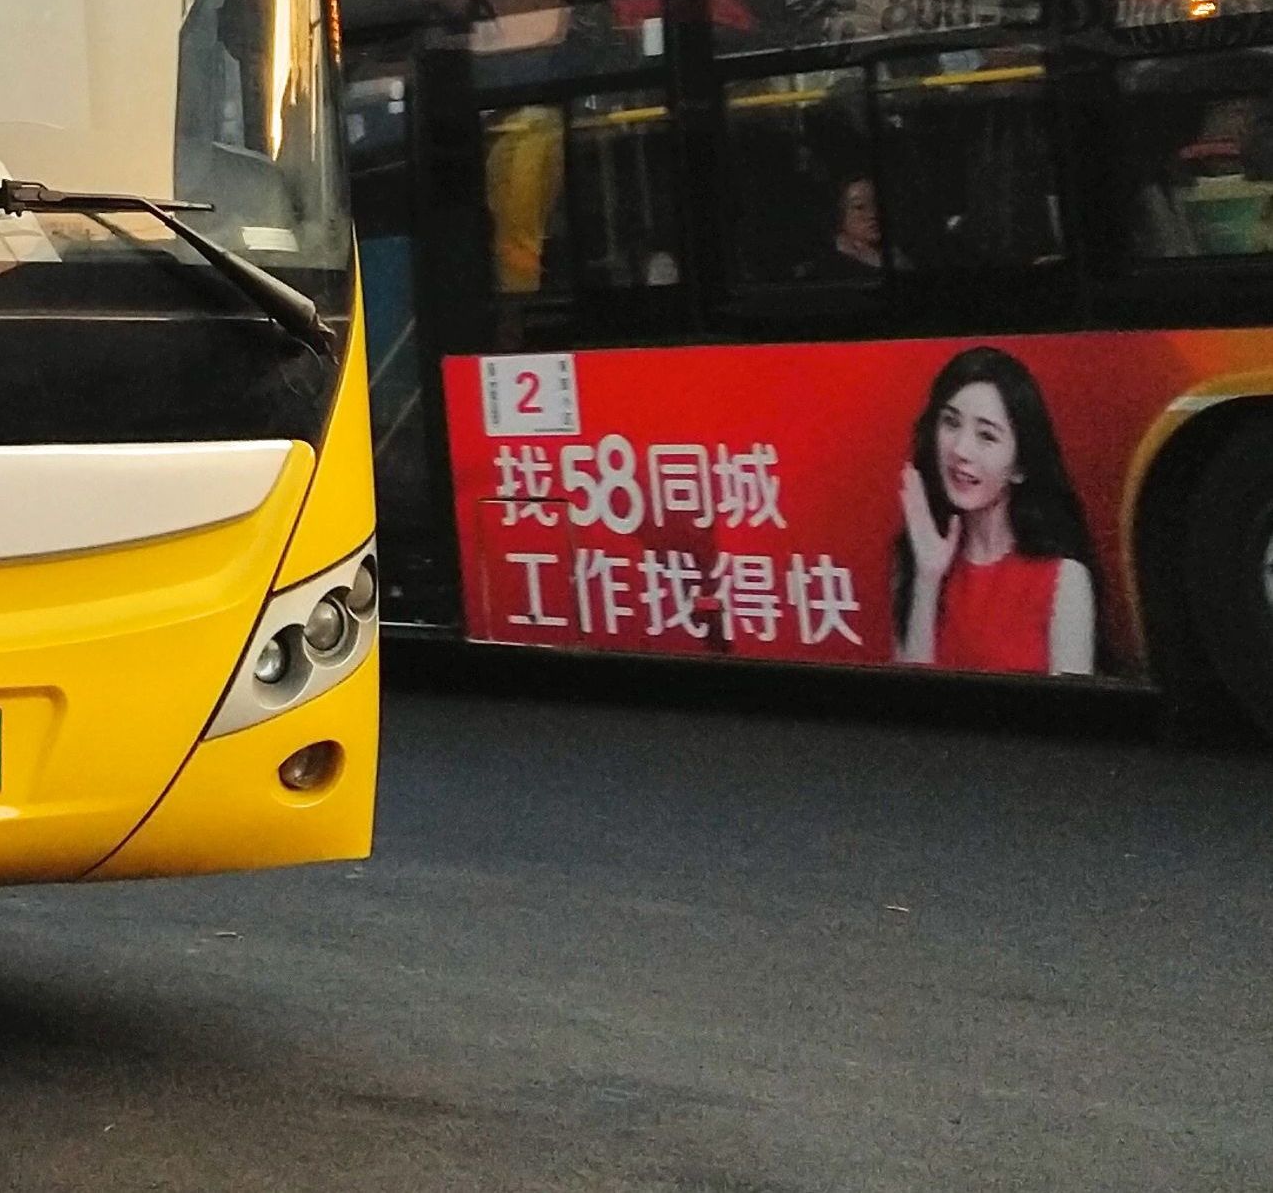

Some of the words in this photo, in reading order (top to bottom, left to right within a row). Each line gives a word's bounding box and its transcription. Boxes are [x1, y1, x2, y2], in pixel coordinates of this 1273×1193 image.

[516, 371, 543, 414] 2
[494, 433, 788, 535] 找58同城
[504, 549, 863, 646] 工作找得快
